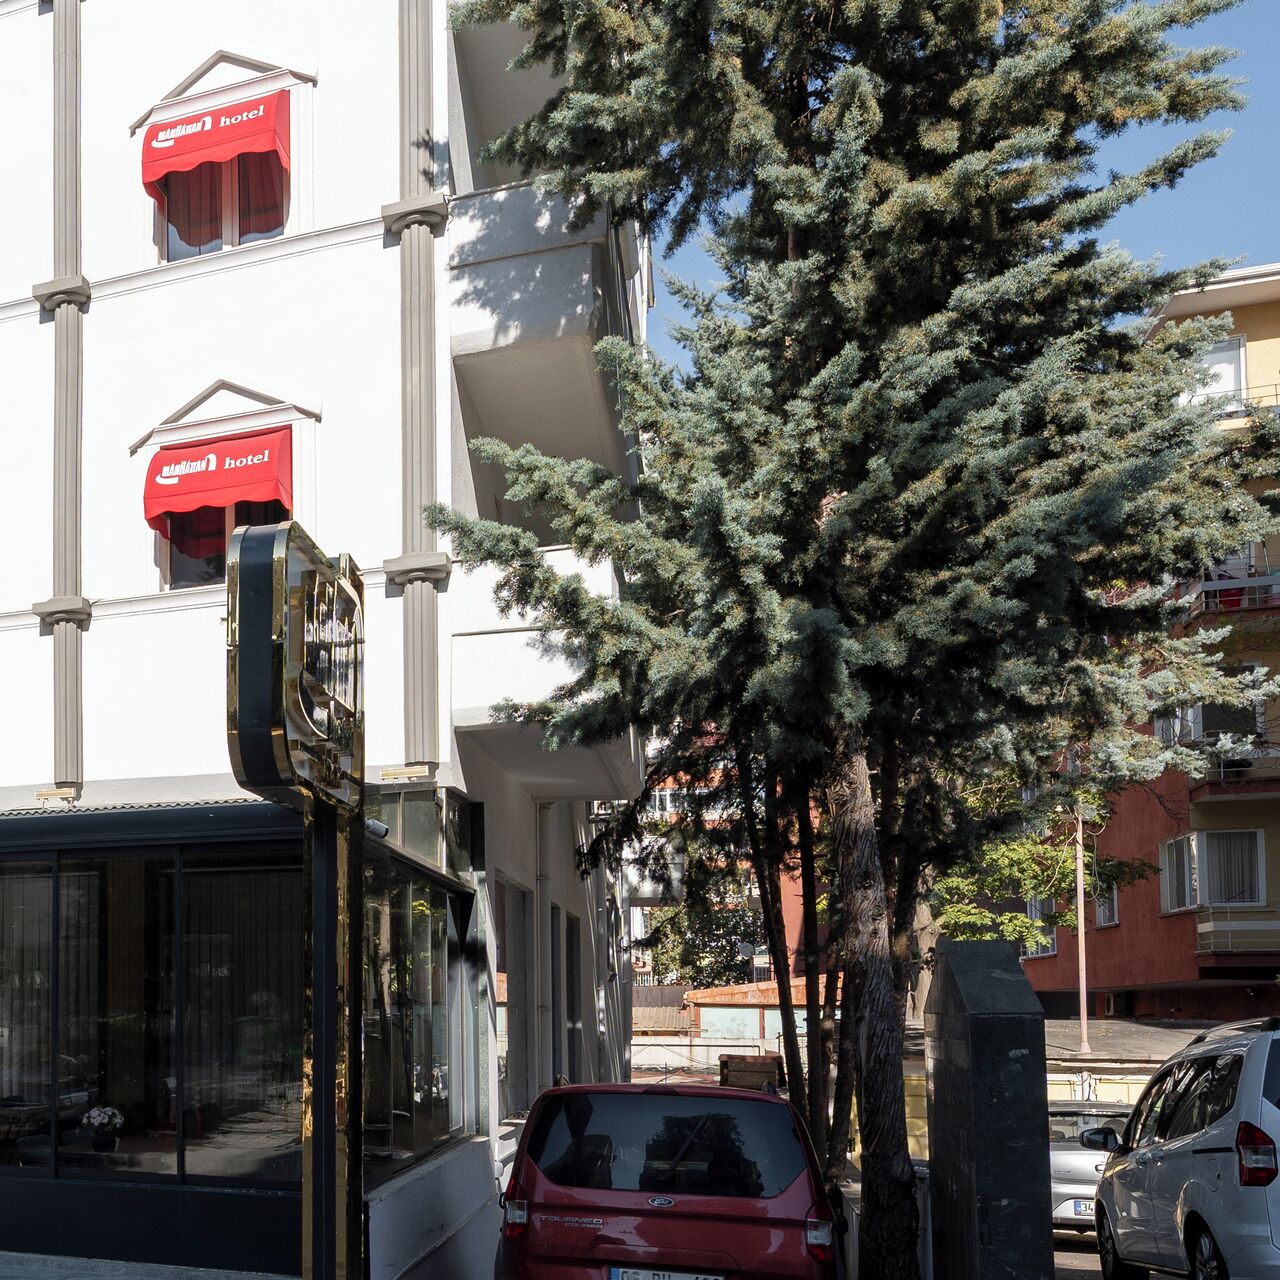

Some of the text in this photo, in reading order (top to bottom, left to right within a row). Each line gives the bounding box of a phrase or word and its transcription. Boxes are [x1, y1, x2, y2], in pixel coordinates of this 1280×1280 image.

[151, 105, 265, 148] MANHATTAN hotel
[156, 450, 270, 484] MANHATTAN hotel
[1081, 1202, 1093, 1212] 34
